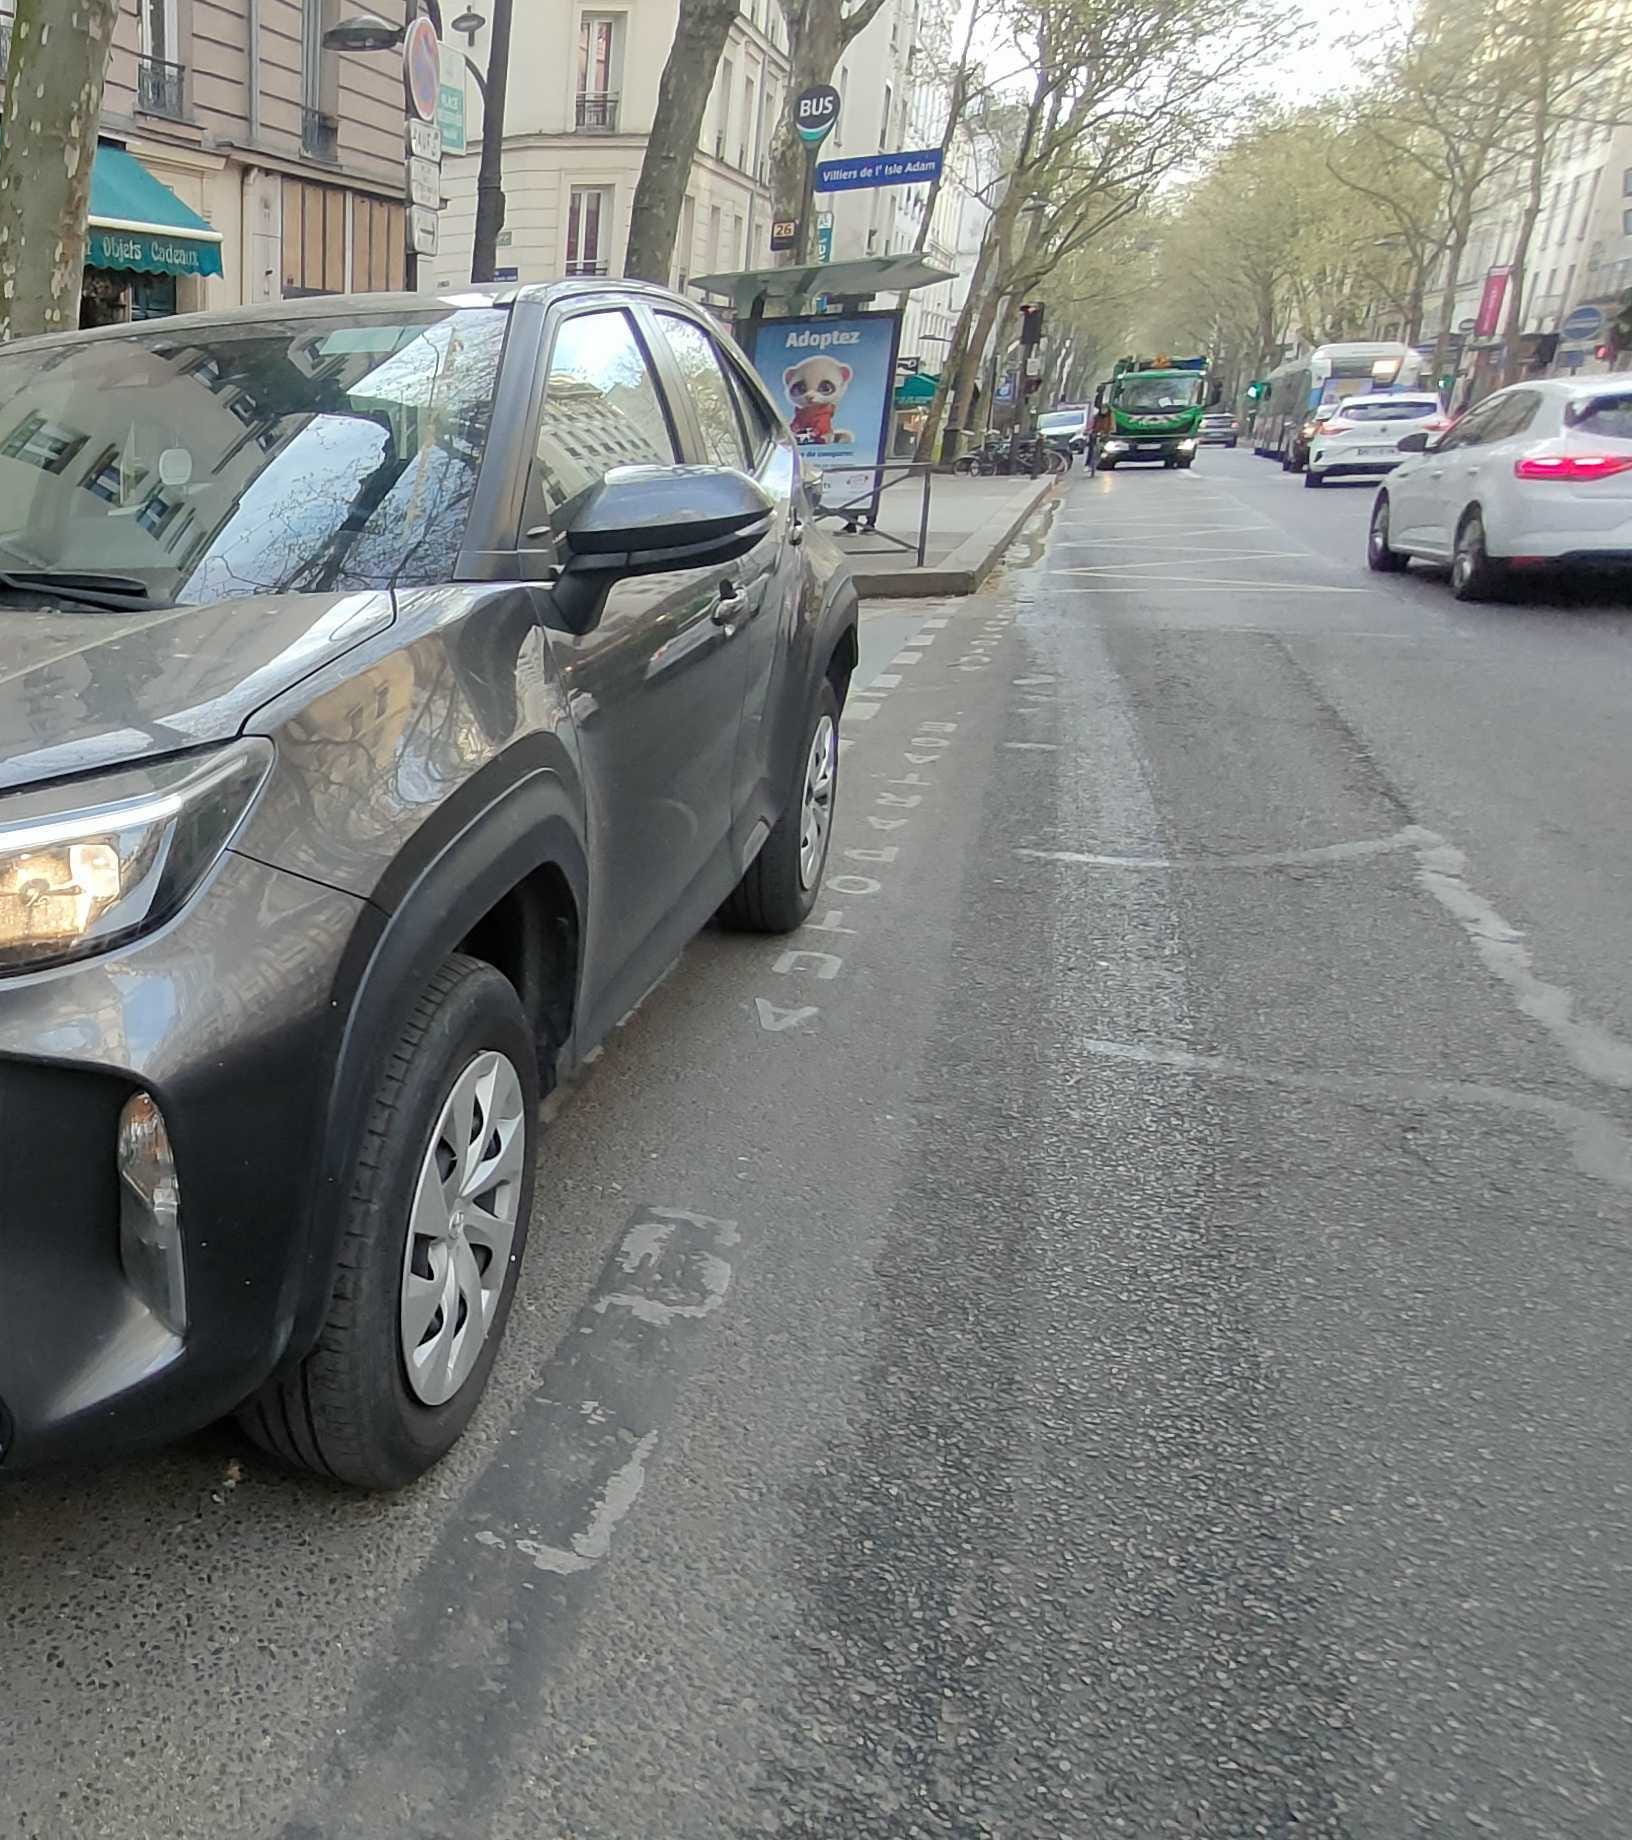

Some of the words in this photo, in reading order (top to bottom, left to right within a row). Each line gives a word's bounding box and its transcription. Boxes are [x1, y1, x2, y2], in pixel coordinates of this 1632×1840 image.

[800, 96, 834, 118] BUS
[823, 170, 858, 182] Villiers
[860, 167, 872, 178] de
[884, 163, 903, 175] Isle
[904, 160, 936, 173] Adam
[775, 224, 792, 236] 26
[103, 236, 142, 262] Objets
[151, 241, 200, 266] Cadeaux
[785, 330, 861, 349] Adoptez
